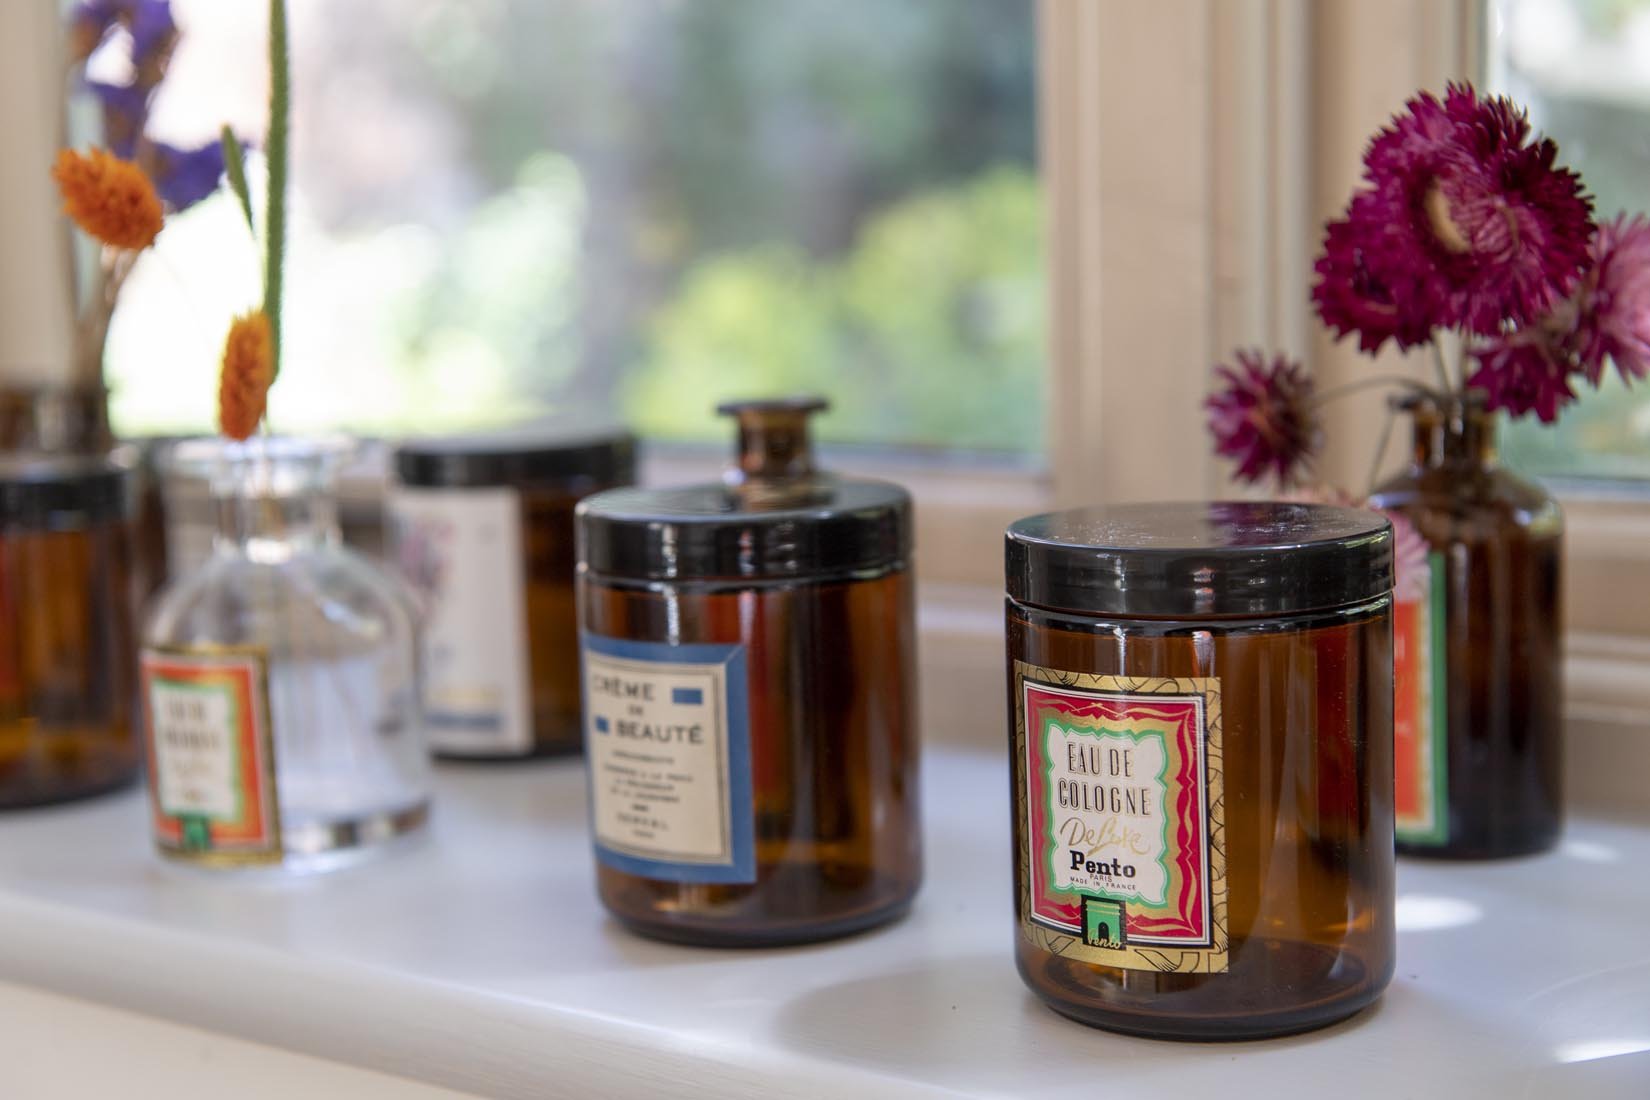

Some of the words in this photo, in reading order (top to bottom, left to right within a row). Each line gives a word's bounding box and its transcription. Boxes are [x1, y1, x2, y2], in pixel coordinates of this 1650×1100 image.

[616, 719, 704, 745] BEAUTÉ
[1067, 742, 1102, 775] EAU
[1109, 748, 1134, 778] DE
[1058, 778, 1152, 816] COLOGNE
[1069, 850, 1137, 878] Pento
[1070, 876, 1088, 885] MADE
[1106, 883, 1136, 891] FRANCE
[1089, 873, 1113, 883] PARIS
